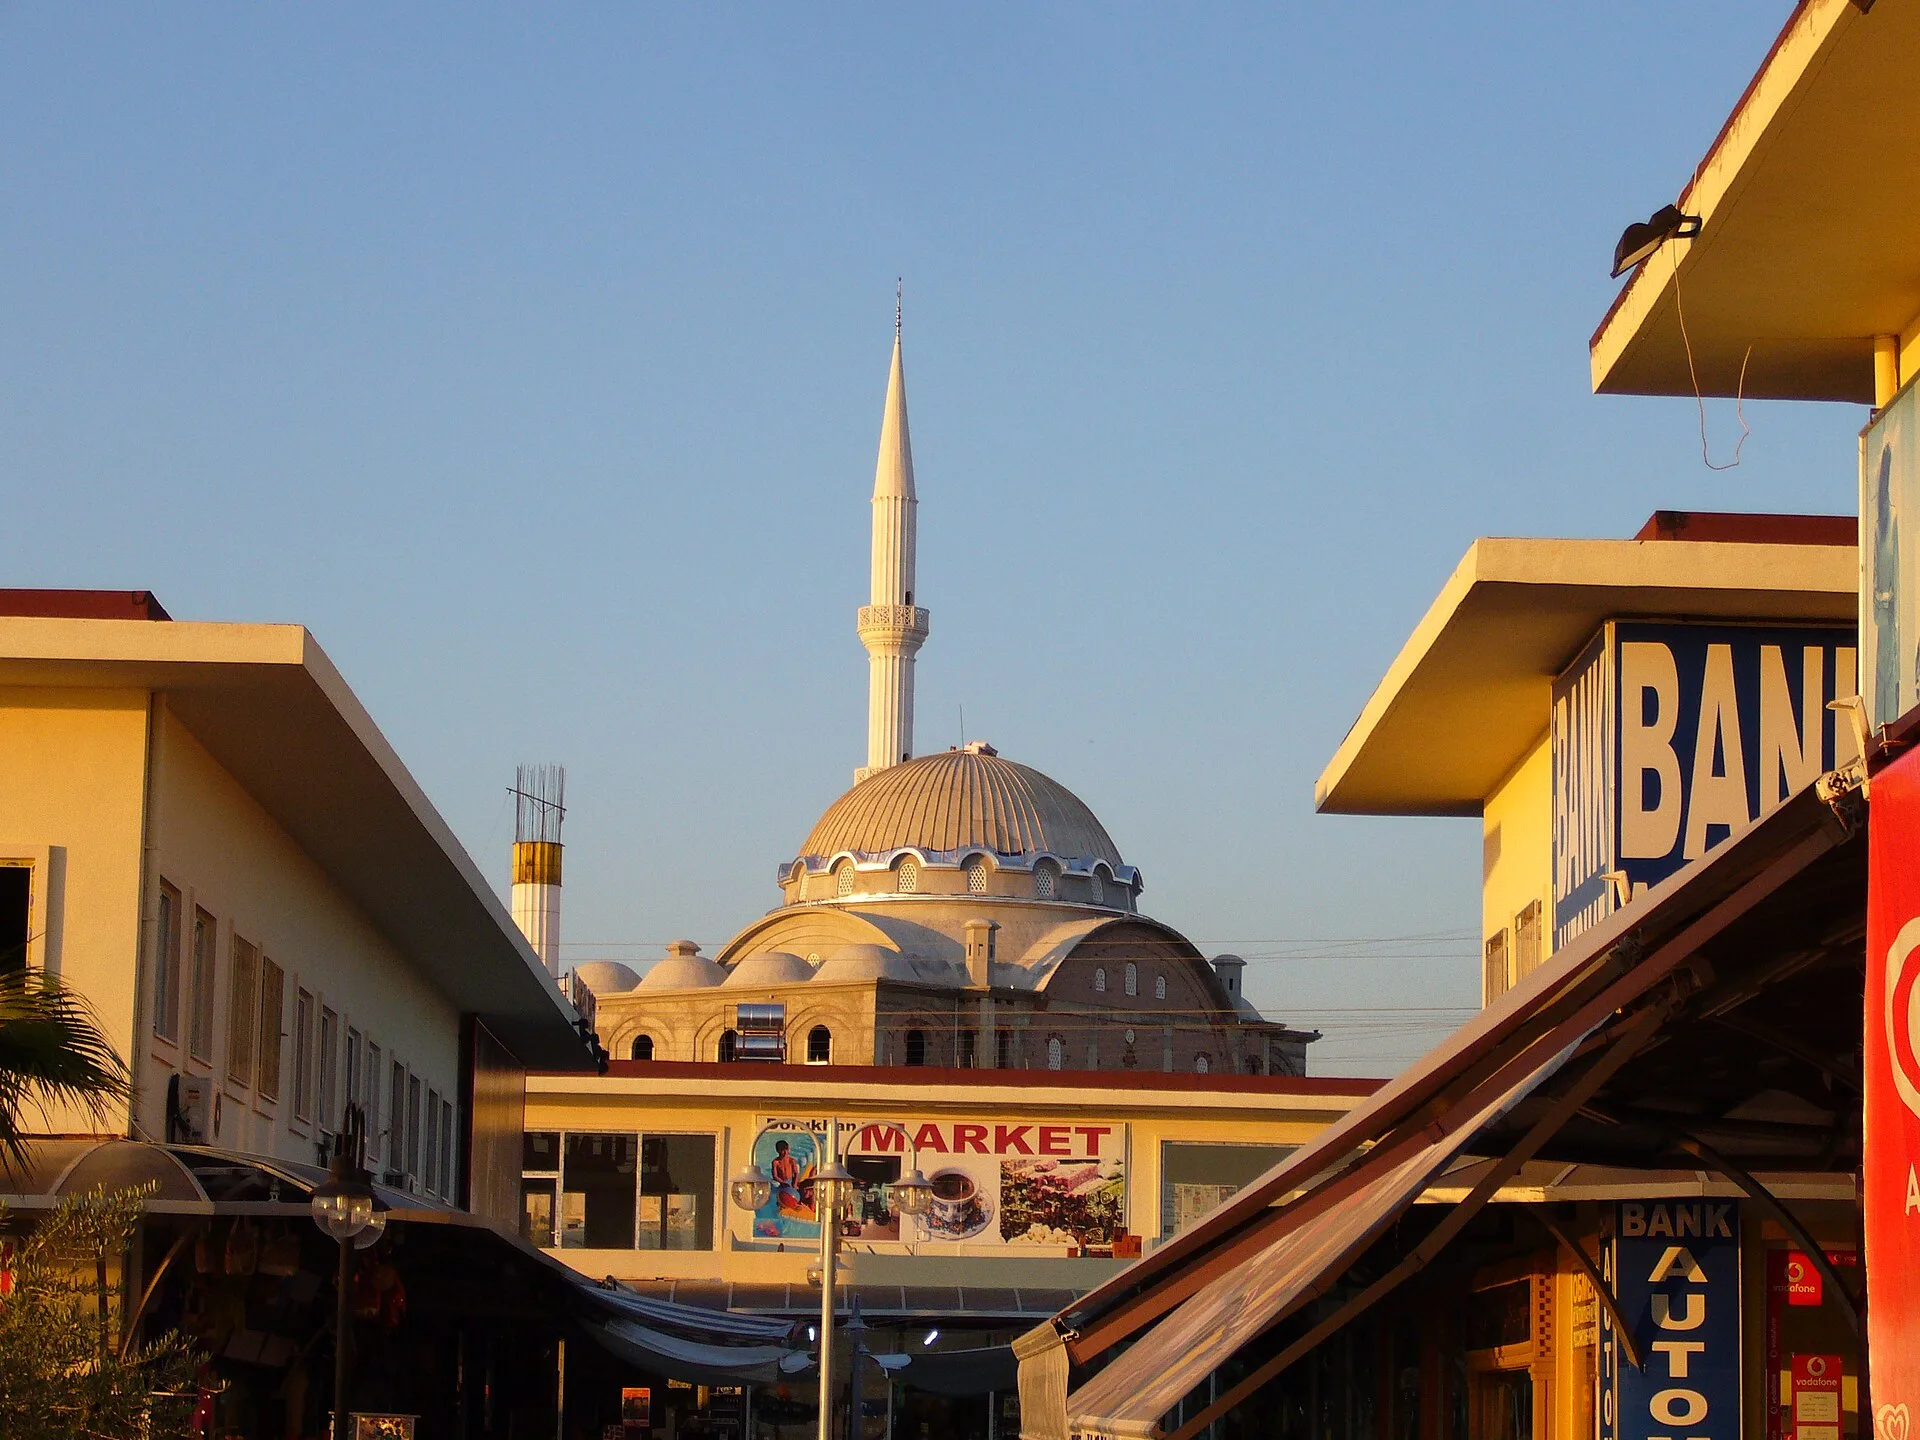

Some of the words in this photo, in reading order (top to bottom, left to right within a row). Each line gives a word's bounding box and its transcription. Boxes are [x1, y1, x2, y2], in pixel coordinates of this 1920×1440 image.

[1557, 650, 1605, 903] BANK
[861, 1123, 1111, 1156] MARKET
[1622, 1203, 1733, 1238] BANK
[1773, 1283, 1815, 1293] vodafone
[1603, 1246, 1612, 1440] AUTO
[1647, 1246, 1711, 1440] AUTO
[1796, 1378, 1838, 1387] vodafone
